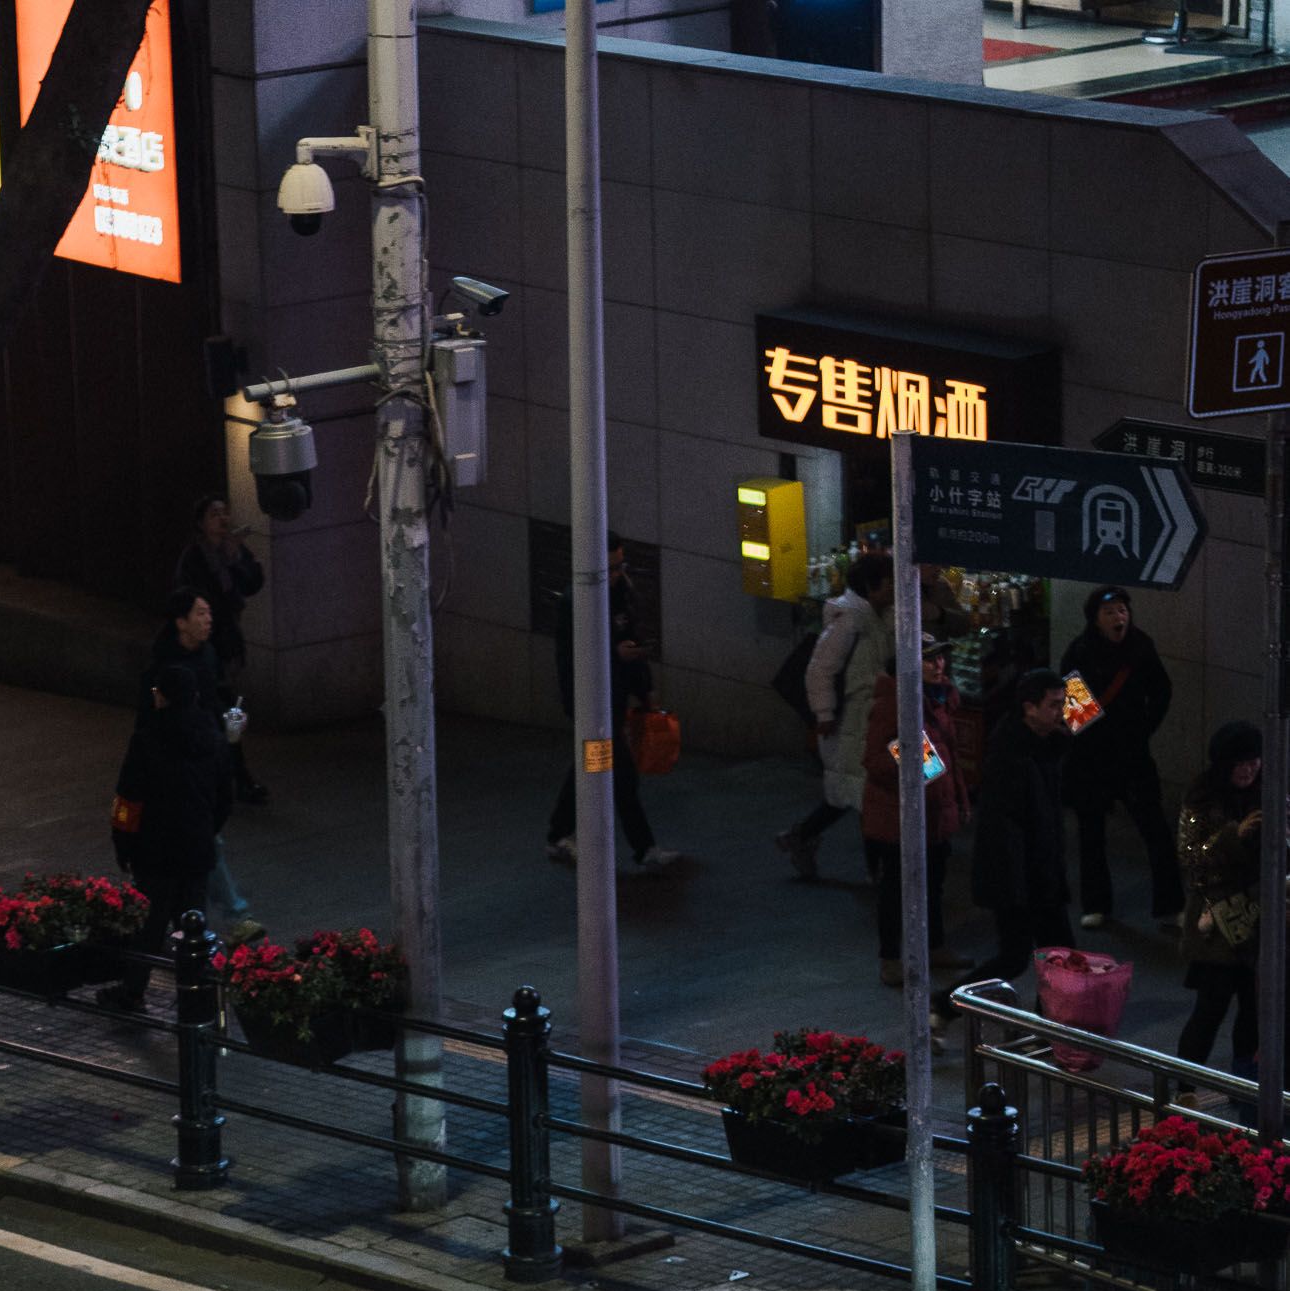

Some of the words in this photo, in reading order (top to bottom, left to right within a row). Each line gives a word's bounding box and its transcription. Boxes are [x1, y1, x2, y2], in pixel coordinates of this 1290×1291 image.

[1214, 305, 1271, 321] Hongyadong
[765, 347, 988, 441] 专售烟酒
[929, 483, 1002, 509] 小什字站
[971, 507, 1003, 521] Station
